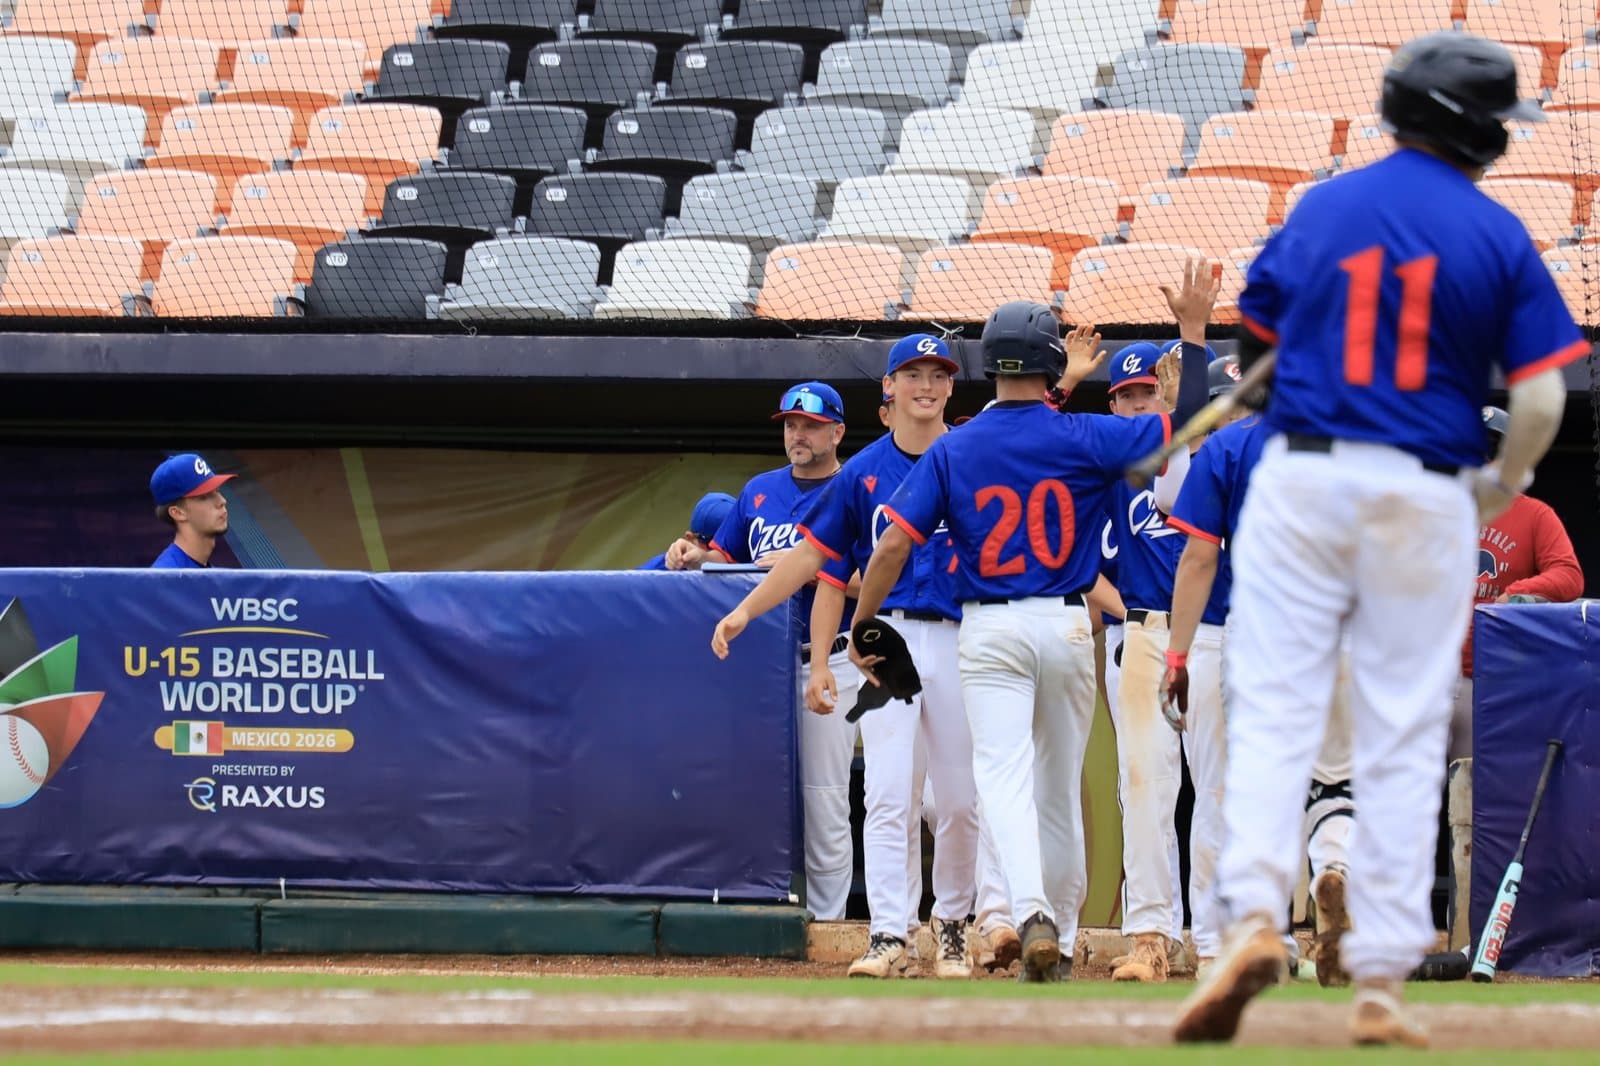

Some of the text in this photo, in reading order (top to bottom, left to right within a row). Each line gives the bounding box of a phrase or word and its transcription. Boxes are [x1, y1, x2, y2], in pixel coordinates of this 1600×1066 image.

[1338, 244, 1439, 392] 11
[1122, 353, 1142, 375] CZ
[974, 478, 1075, 577] 20
[1480, 525, 1516, 554] STALE
[210, 597, 299, 622] WBSC
[124, 646, 385, 680] U-15 BASEBALL
[159, 680, 286, 713] WORLD
[231, 730, 337, 748] MEXICO 2026
[212, 764, 296, 777] PRESENTED BY
[221, 784, 326, 808] RAXUS
